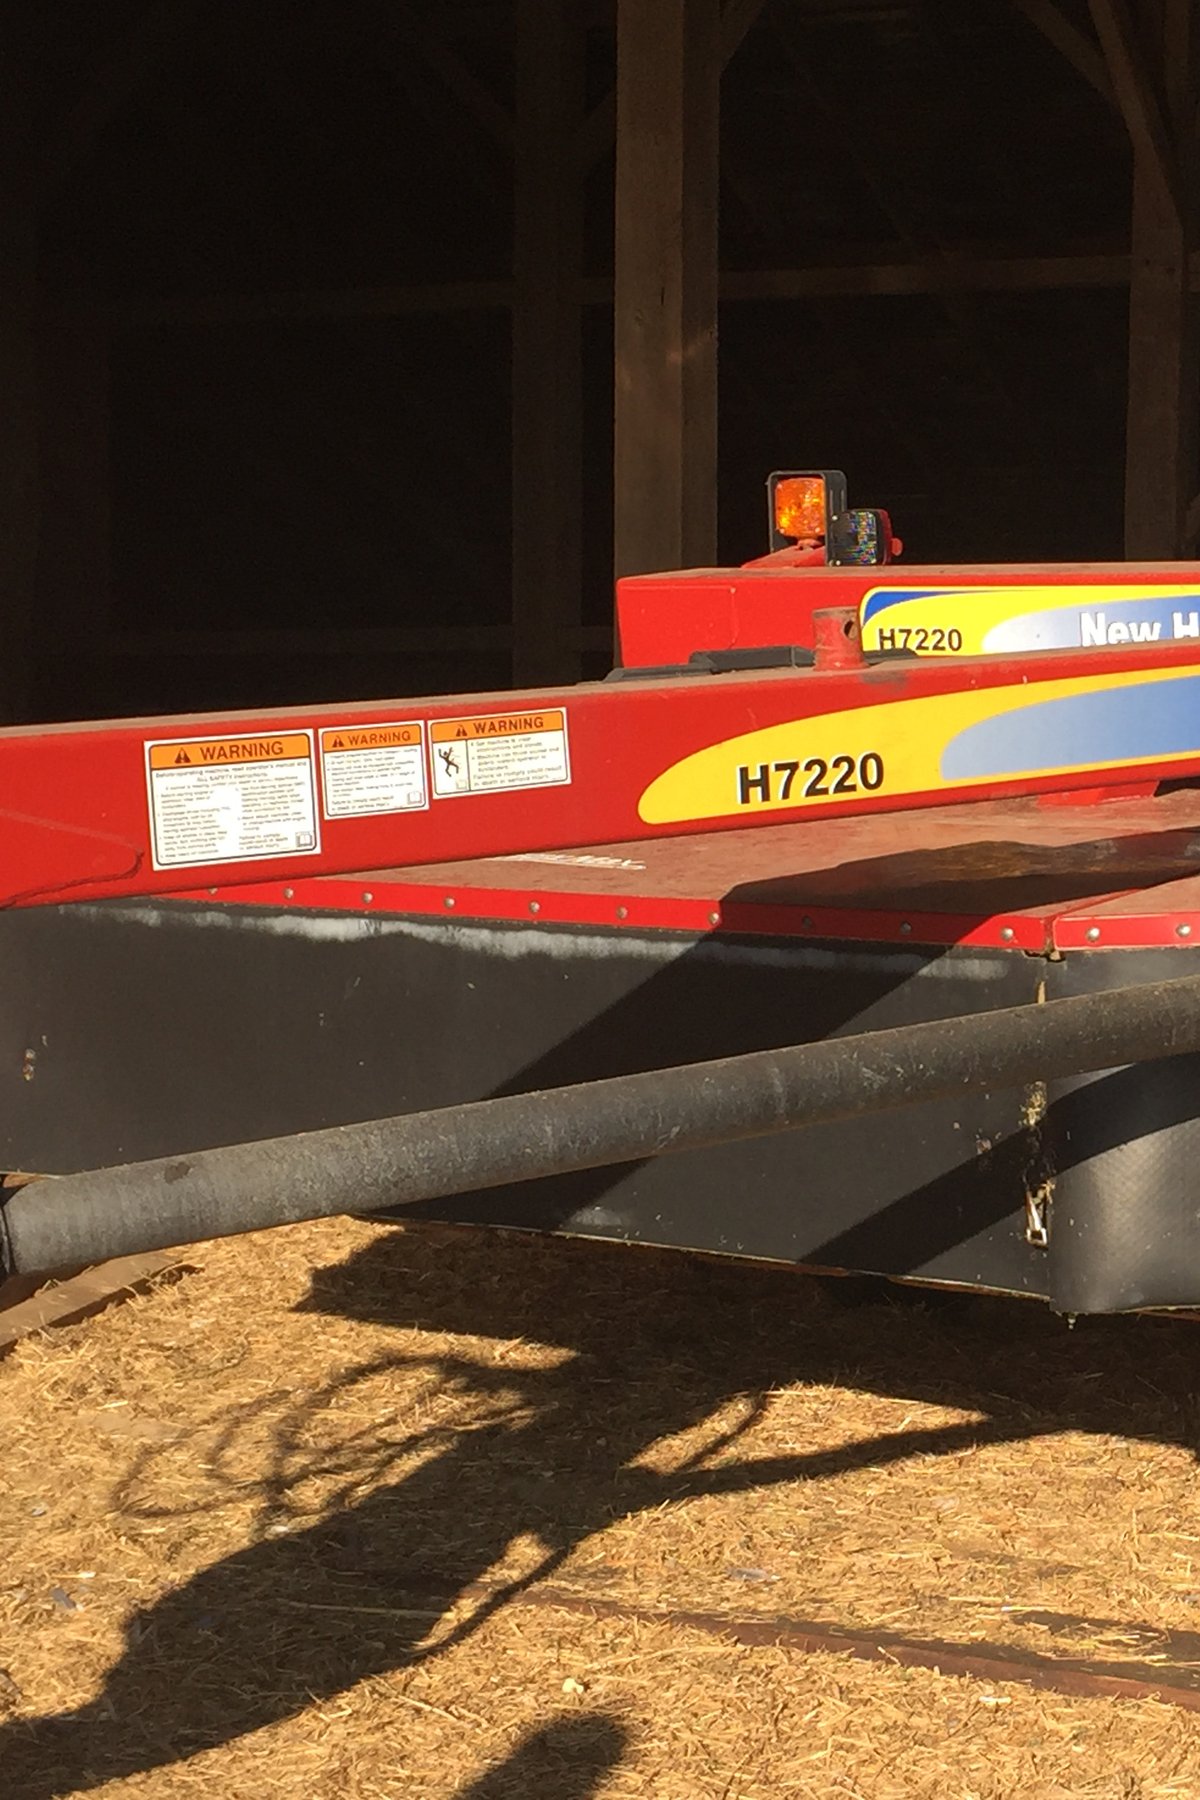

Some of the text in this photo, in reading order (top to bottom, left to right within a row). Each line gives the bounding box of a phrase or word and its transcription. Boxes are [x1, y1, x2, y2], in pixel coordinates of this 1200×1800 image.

[879, 628, 962, 651] H7220
[1080, 612, 1161, 646] New
[473, 716, 544, 734] WARNING
[347, 730, 411, 746] WARNING
[200, 741, 284, 761] WARNING
[737, 752, 884, 804] H7220
